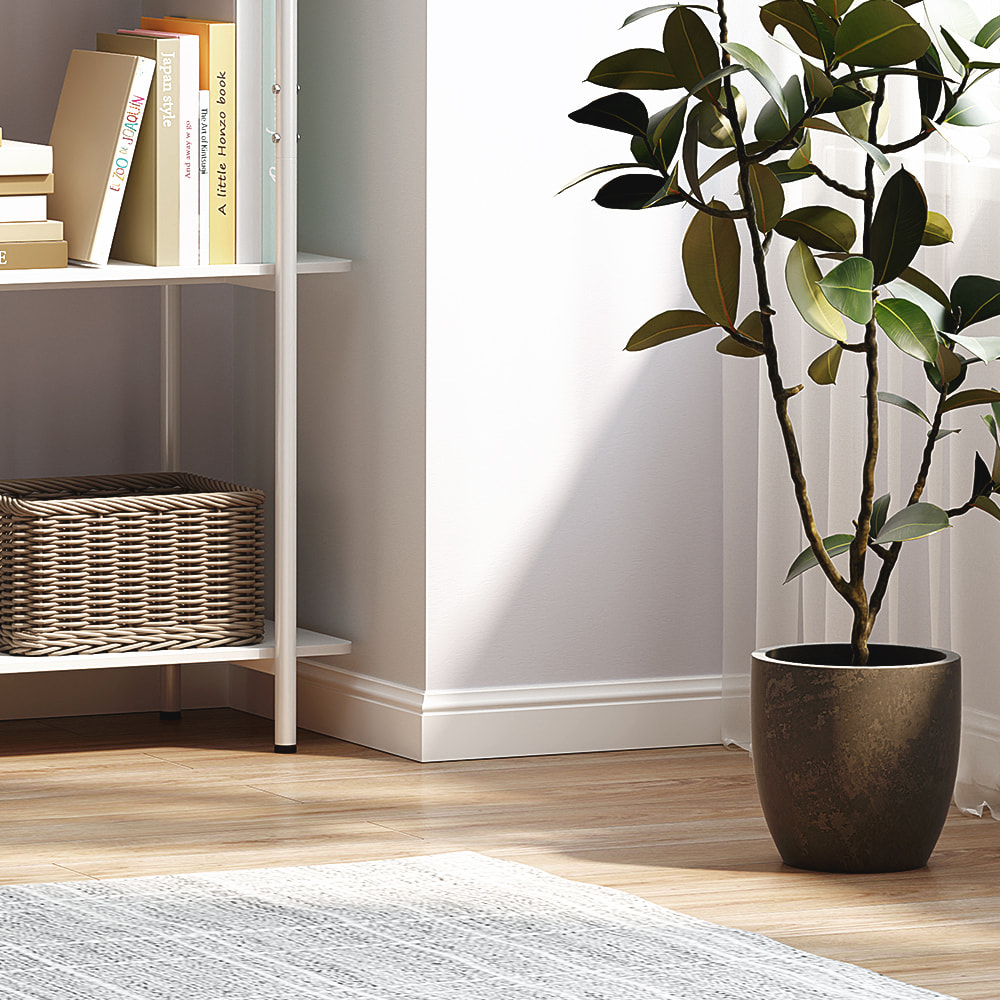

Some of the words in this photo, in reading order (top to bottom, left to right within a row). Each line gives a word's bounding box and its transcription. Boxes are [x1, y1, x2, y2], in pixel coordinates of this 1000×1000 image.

[161, 52, 176, 92] Japan
[217, 71, 227, 105] book
[159, 95, 176, 127] style
[186, 120, 192, 130] go
[185, 140, 193, 160] away
[217, 111, 227, 156] Honzo
[217, 163, 227, 197] little
[218, 203, 227, 216] A
